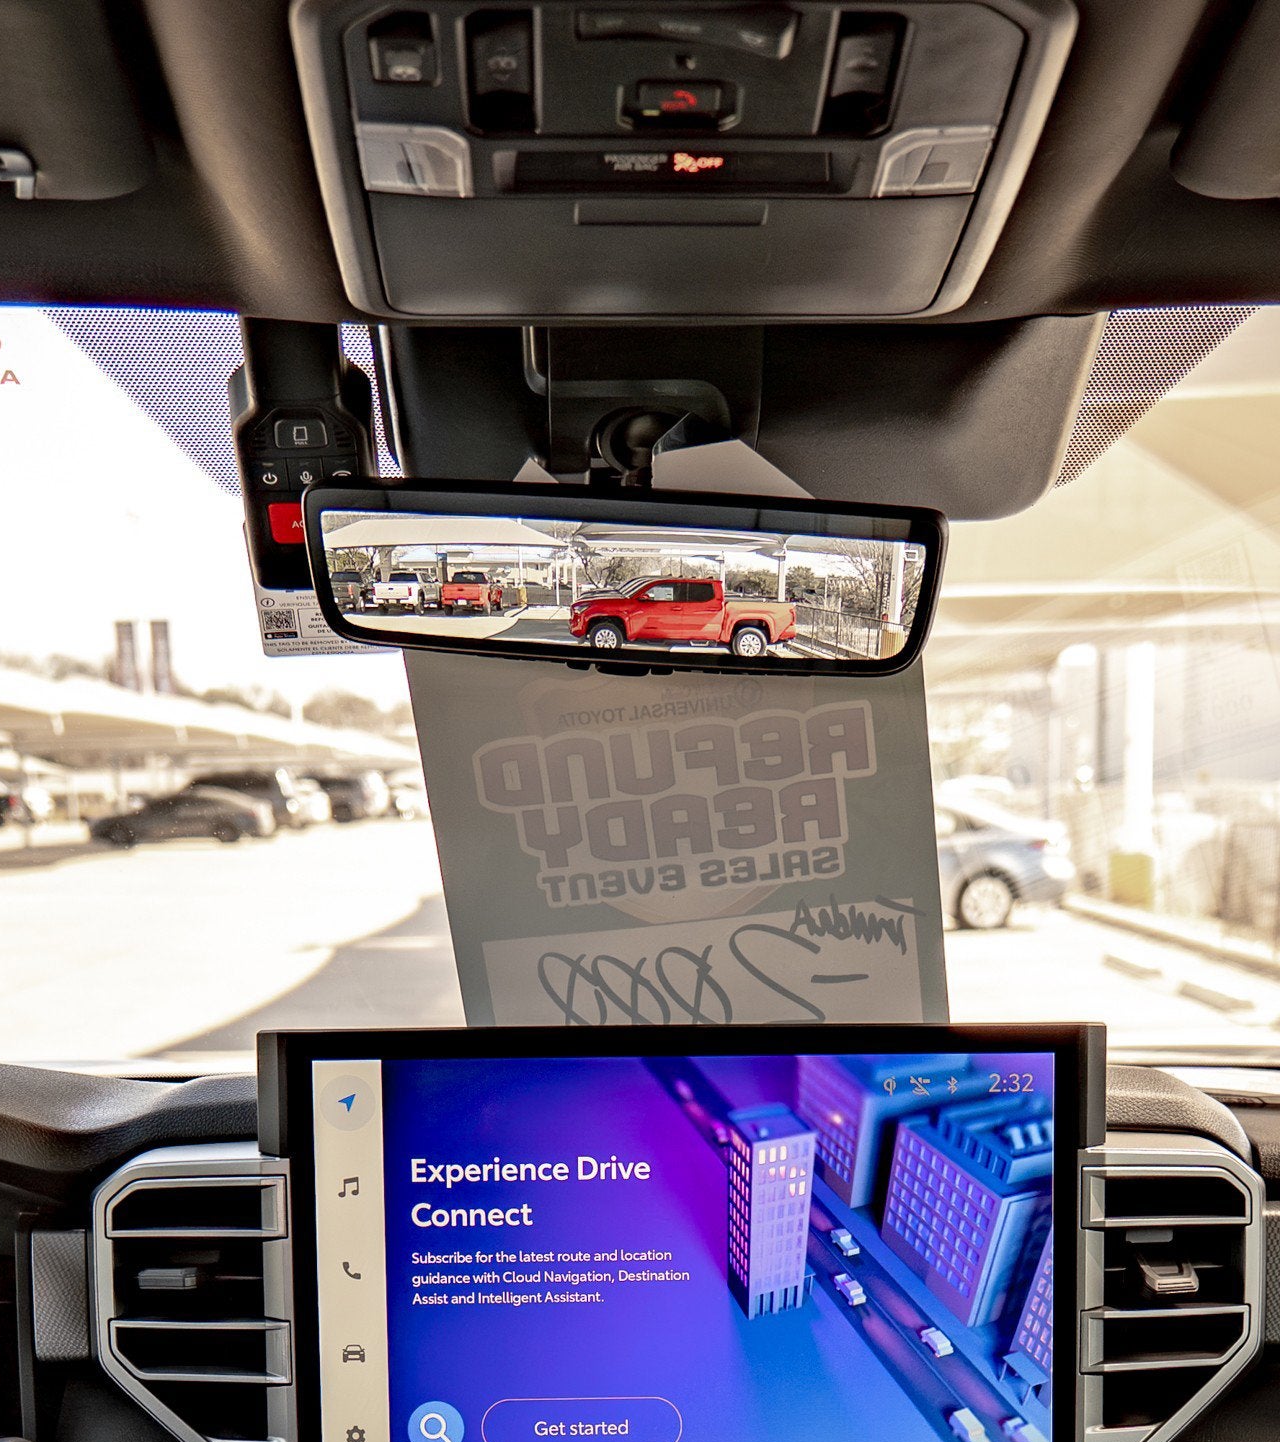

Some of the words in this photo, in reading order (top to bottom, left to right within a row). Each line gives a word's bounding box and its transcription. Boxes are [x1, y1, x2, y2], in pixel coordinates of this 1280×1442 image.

[988, 1073, 1035, 1093] 2:32
[410, 1156, 570, 1189] Experience
[577, 1154, 652, 1181] Drive
[410, 1202, 534, 1229] Connect
[411, 1251, 473, 1265] Subscribe
[475, 1250, 493, 1264] for
[495, 1250, 517, 1263] the
[519, 1250, 555, 1263] latest
[557, 1250, 591, 1262] route
[593, 1249, 618, 1262] and
[620, 1248, 672, 1261] location
[412, 1271, 470, 1286] guidance
[472, 1270, 500, 1284] with
[502, 1269, 542, 1283] Cloud
[543, 1269, 615, 1286] Navigation,
[618, 1268, 690, 1282] Destination
[412, 1291, 449, 1306] Assist
[451, 1291, 475, 1305] and
[477, 1290, 543, 1307] Intelligent
[544, 1290, 605, 1304] Assistant.
[534, 1420, 567, 1436] Get
[569, 1418, 629, 1436] started
